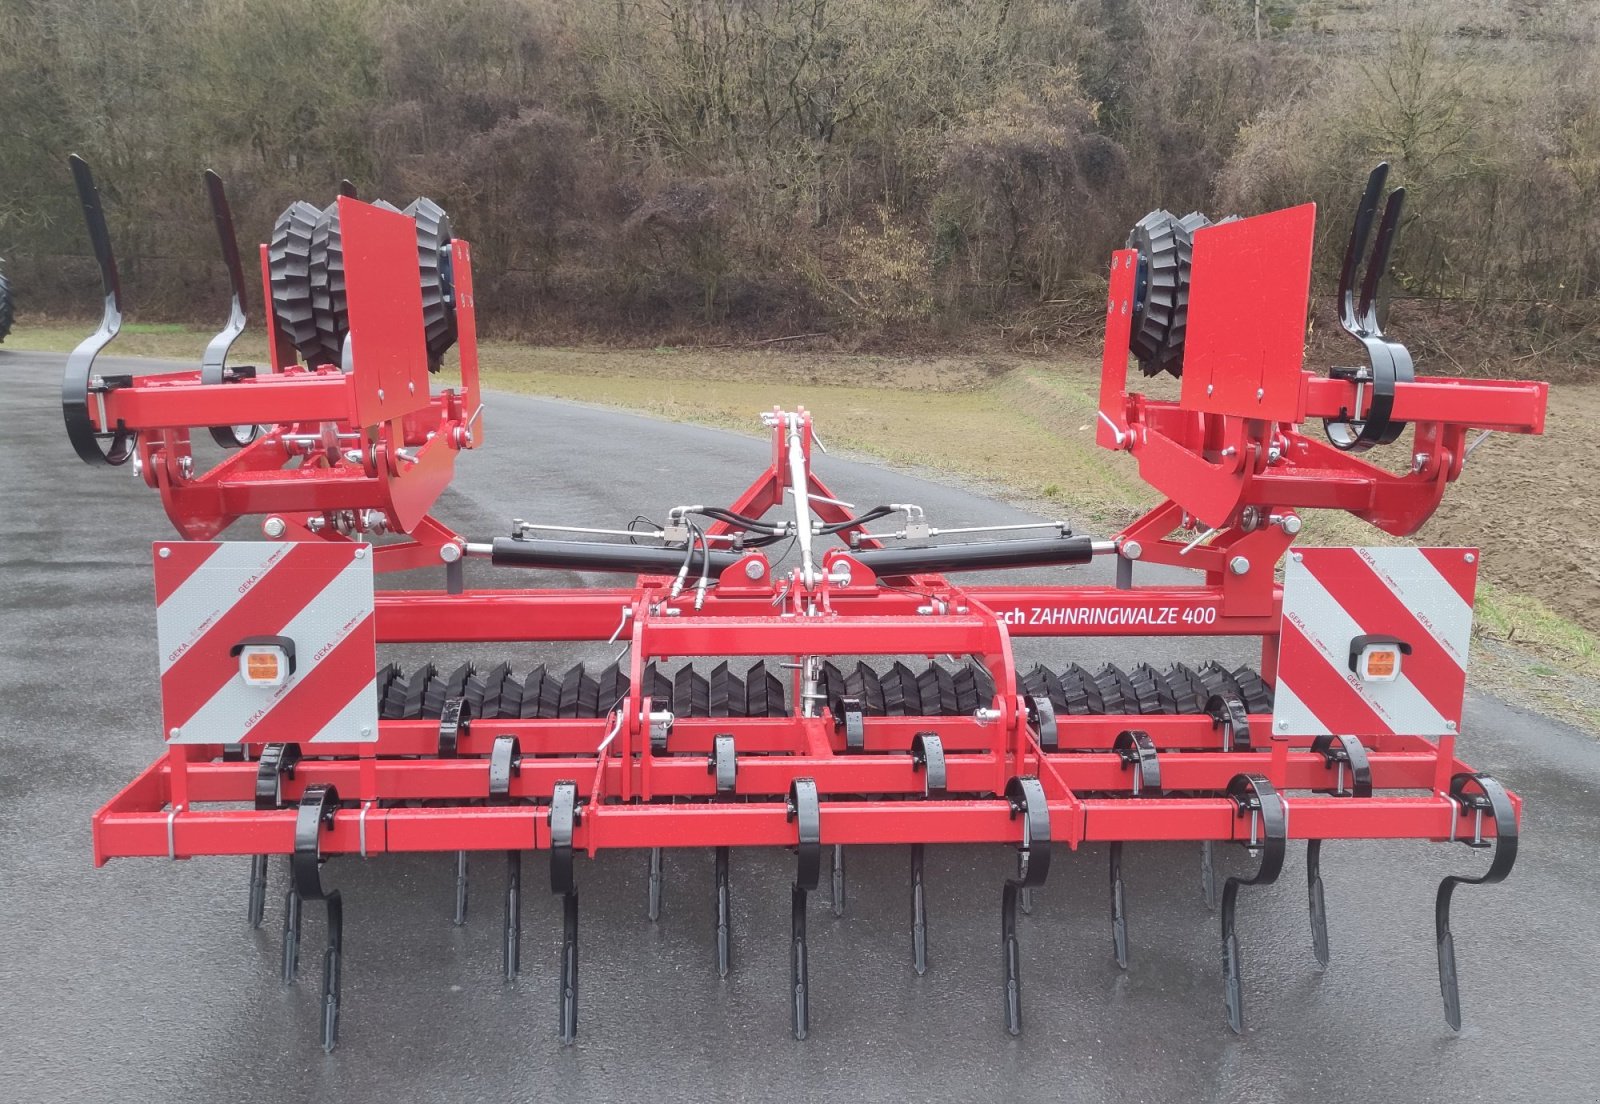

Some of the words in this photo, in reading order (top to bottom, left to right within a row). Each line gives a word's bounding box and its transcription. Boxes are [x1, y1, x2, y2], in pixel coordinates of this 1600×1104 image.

[1359, 548, 1376, 567] GEKA
[238, 575, 258, 594] GEKA
[1029, 607, 1179, 625] ZAHNRINGWALZE
[1182, 607, 1216, 625] 400
[1288, 611, 1306, 630] GEKA
[1416, 611, 1433, 630] GEKA
[168, 643, 190, 662] GEKA
[313, 642, 334, 661] GEKA
[1346, 674, 1364, 693] GEKA
[244, 709, 265, 728] GEKA
